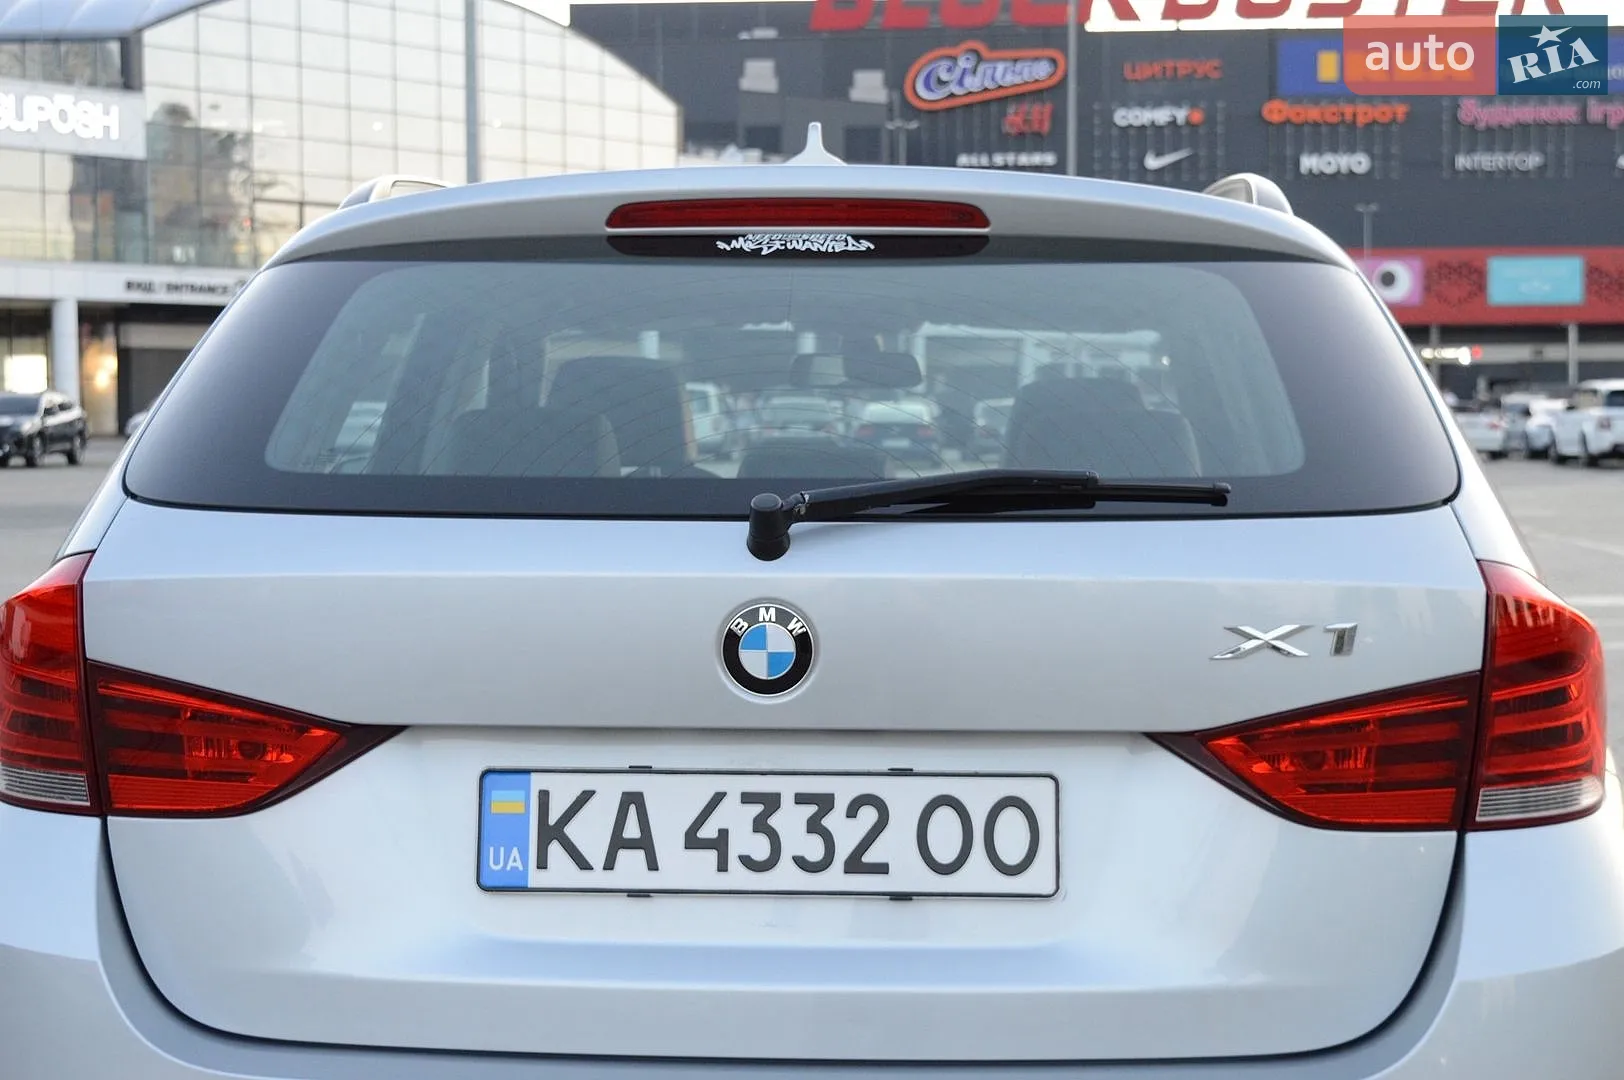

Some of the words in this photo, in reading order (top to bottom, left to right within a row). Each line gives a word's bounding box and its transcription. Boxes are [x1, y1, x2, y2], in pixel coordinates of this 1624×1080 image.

[1123, 60, 1223, 80] ЦИТРУС
[1113, 106, 1188, 127] COMFY
[1262, 98, 1412, 129] Фокстрот
[1300, 152, 1372, 175] MOYO
[1455, 152, 1545, 171] INTERTOP
[730, 606, 807, 637] BMW
[1208, 622, 1358, 660] X1
[536, 789, 659, 872] KA
[684, 791, 890, 874] 4332
[489, 846, 523, 871] UA
